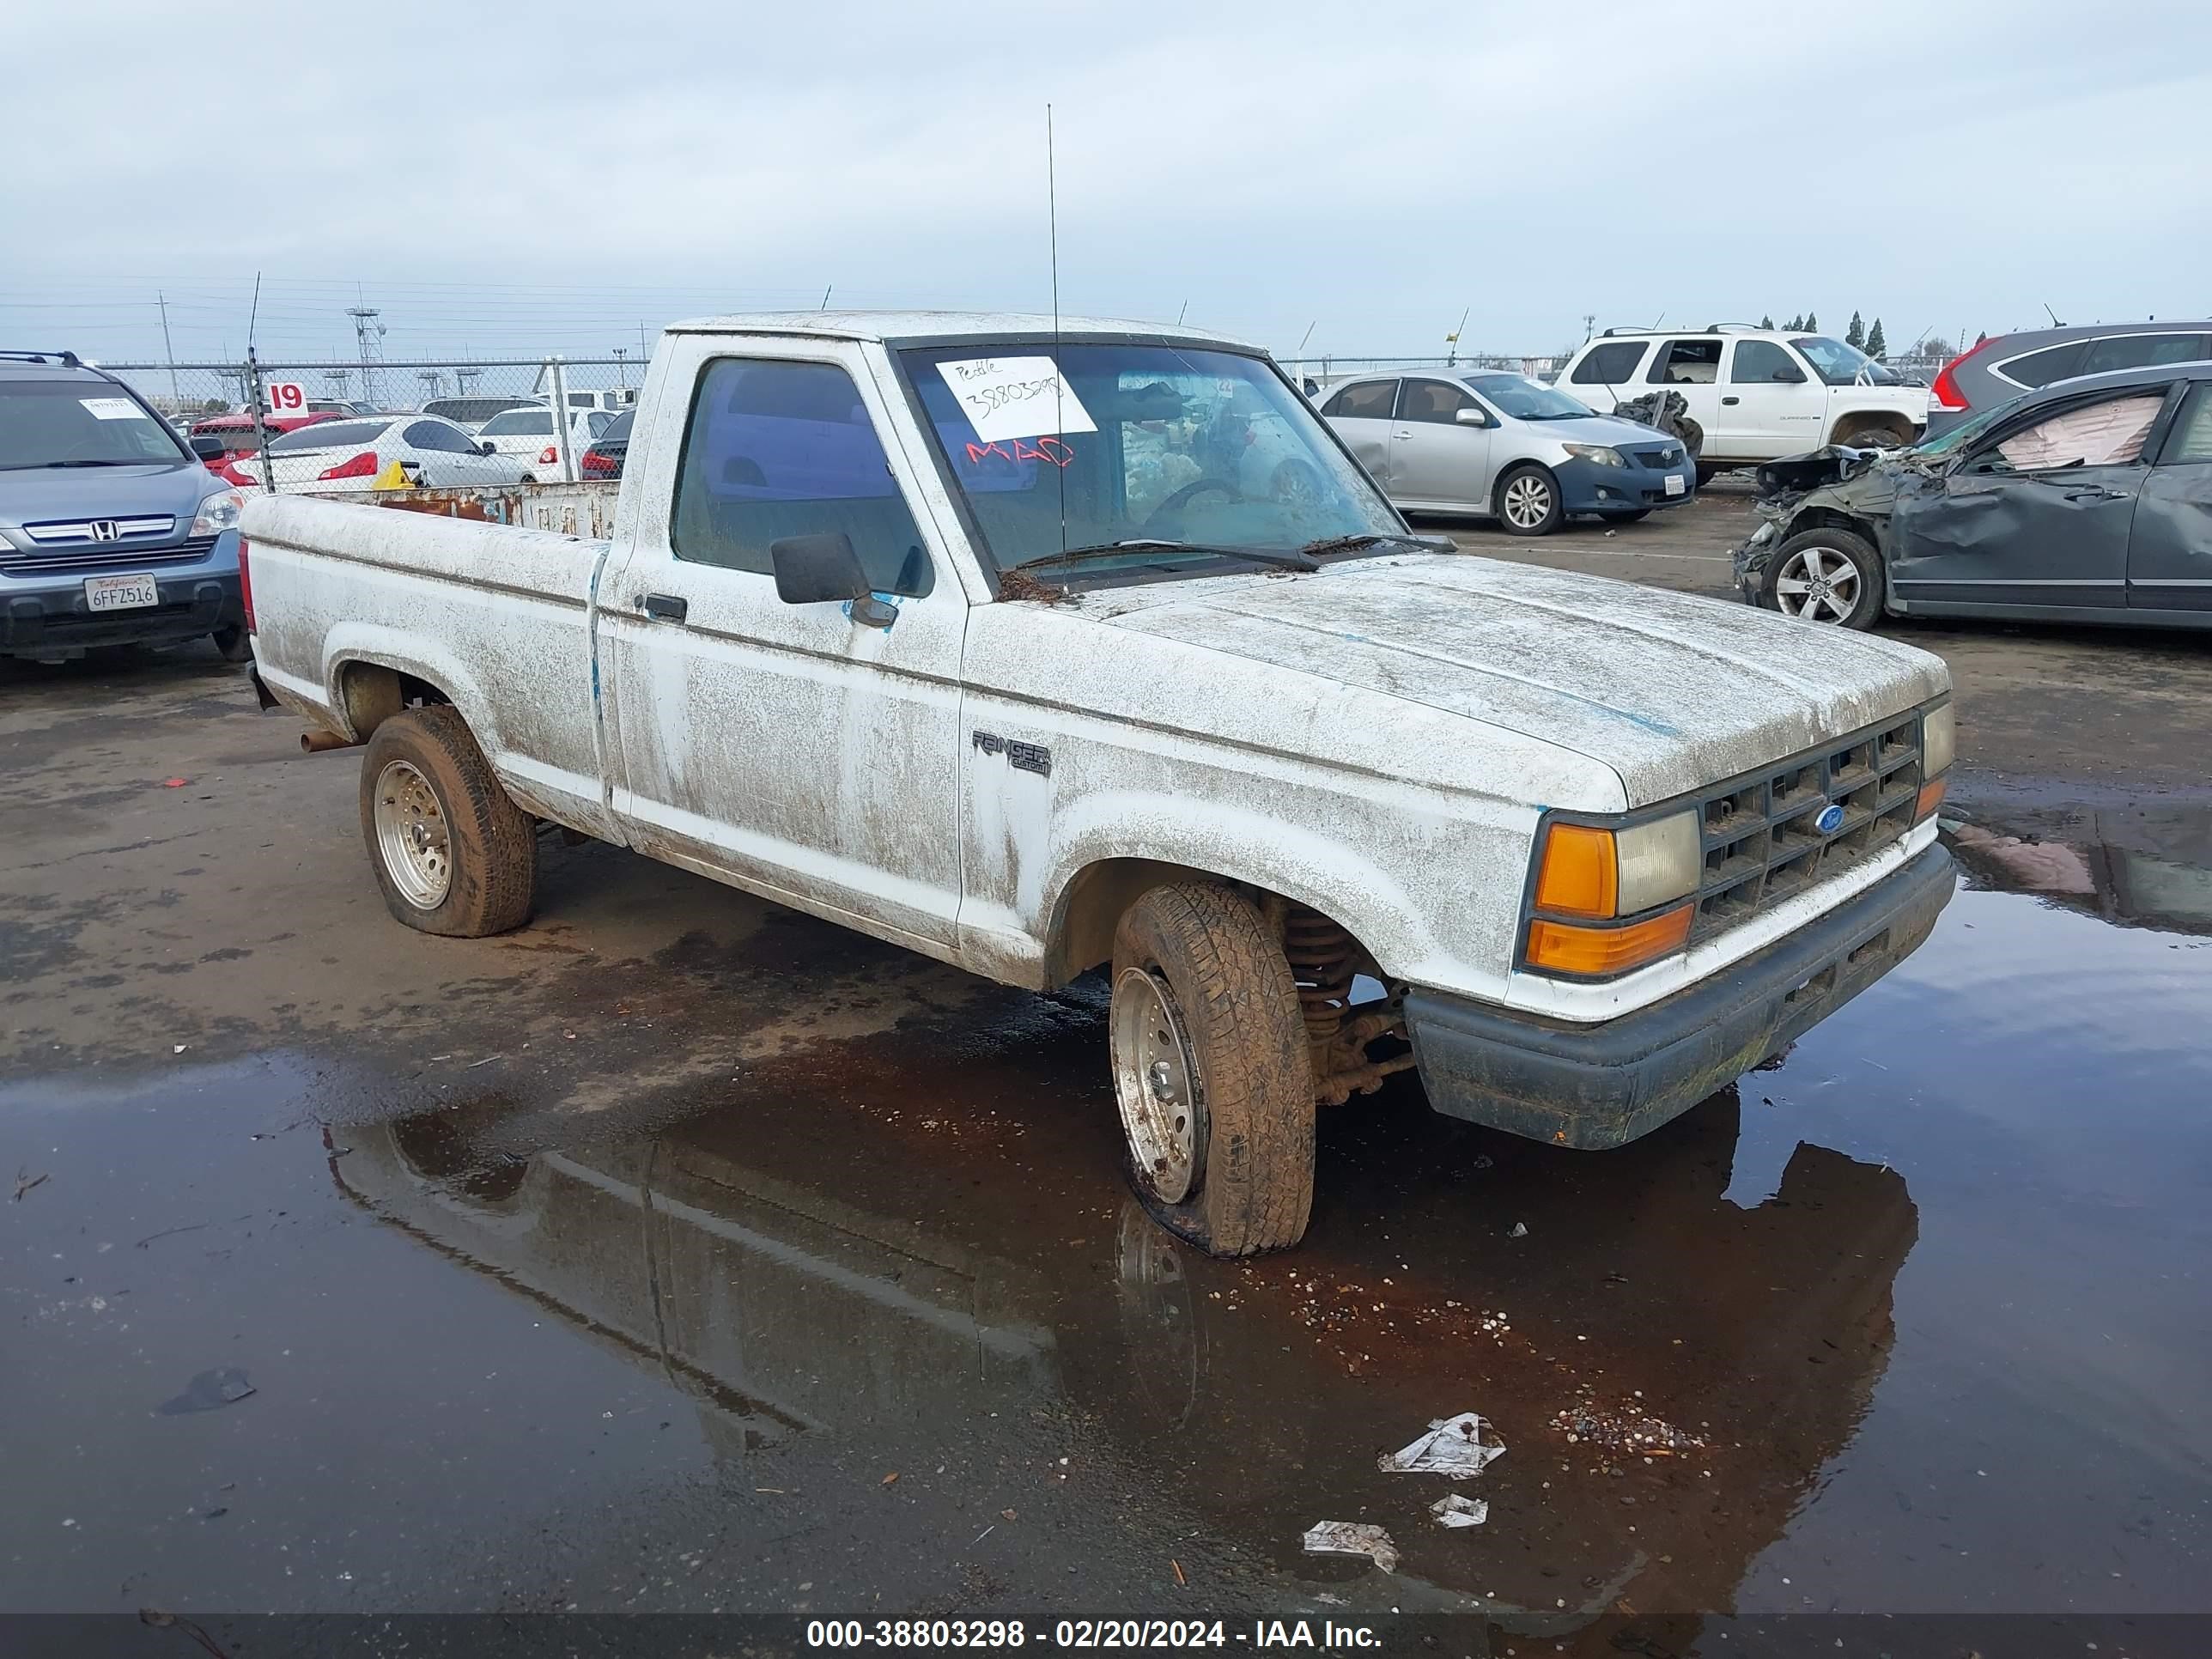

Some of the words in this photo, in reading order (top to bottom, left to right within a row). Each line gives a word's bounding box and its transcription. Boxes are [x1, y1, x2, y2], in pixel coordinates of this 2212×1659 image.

[270, 384, 302, 409] 19
[965, 377, 1064, 419] 38803298
[965, 436, 1075, 467] MAD
[97, 577, 143, 589] California
[93, 586, 153, 606] 6FFZ516
[972, 730, 1051, 763] RANGER
[1012, 757, 1045, 772] CUSTOM
